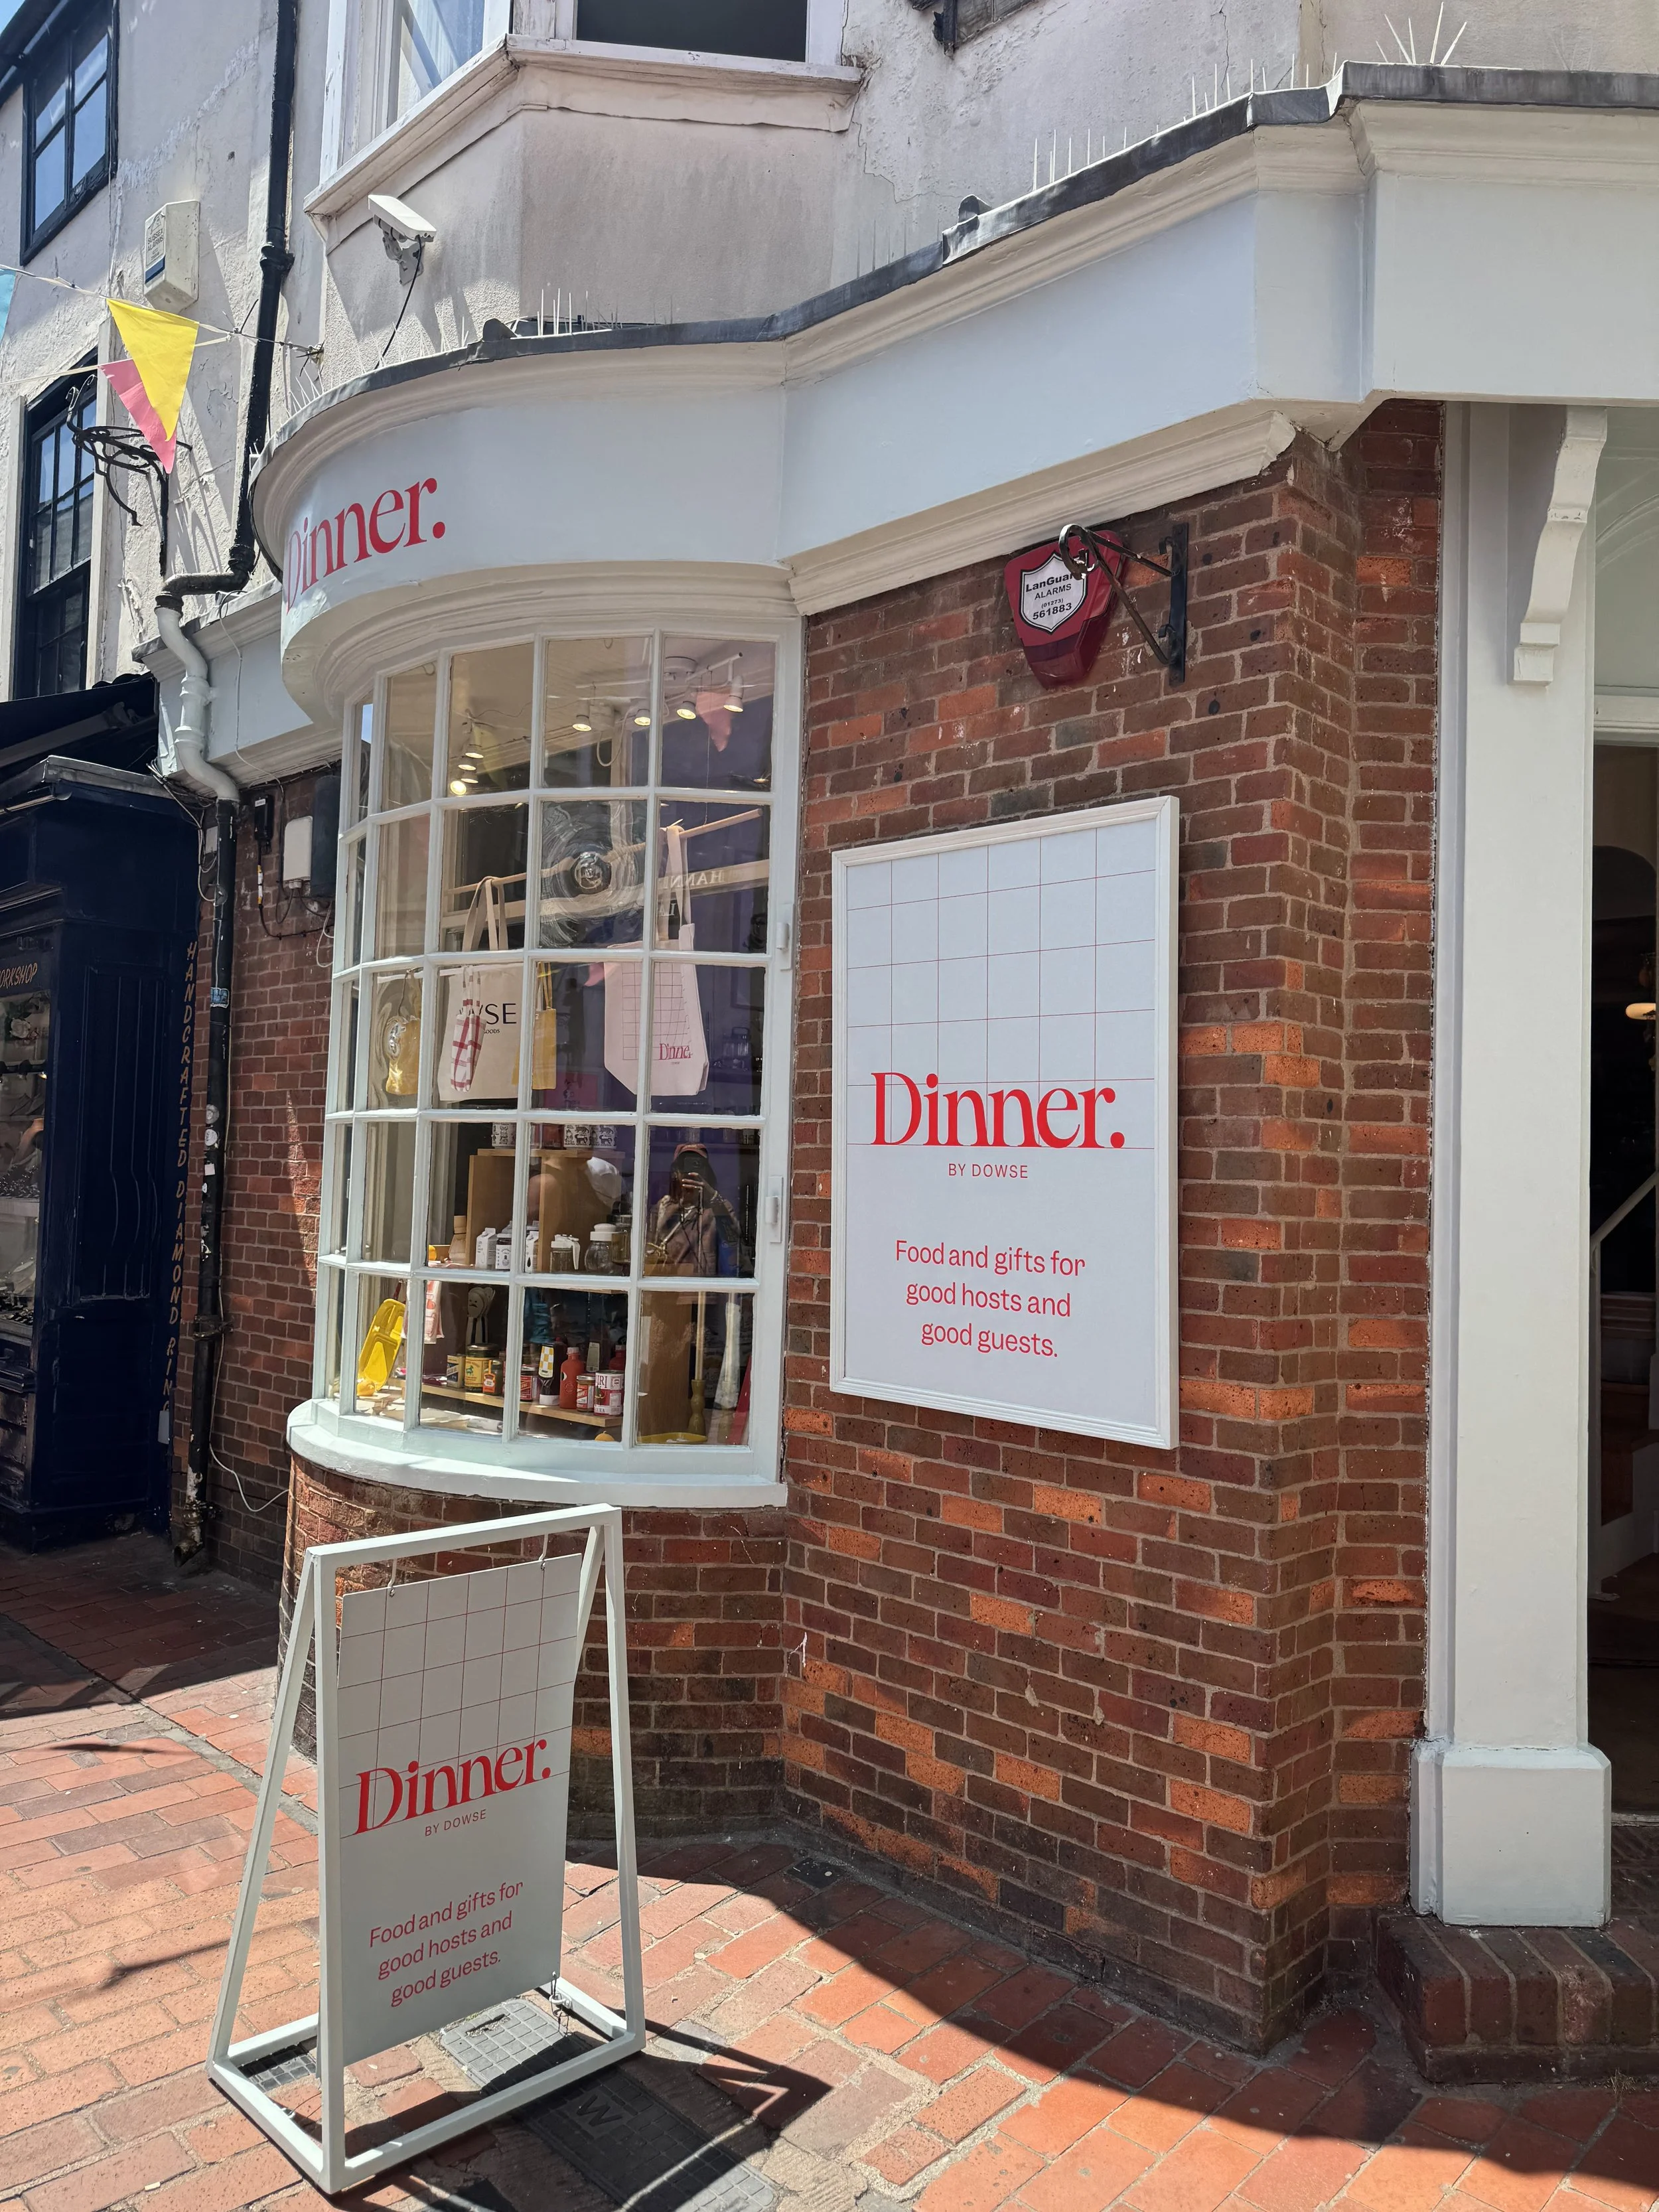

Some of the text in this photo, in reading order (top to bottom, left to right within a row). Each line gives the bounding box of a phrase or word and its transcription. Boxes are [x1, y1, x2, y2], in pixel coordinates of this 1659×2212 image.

[286, 478, 446, 615] Dinner.
[1026, 572, 1076, 592] LanGuar
[1035, 583, 1072, 600] ALARMS
[1033, 603, 1072, 620] 561883
[1041, 598, 1064, 609] (01273)
[0, 962, 38, 989] ORKSHOP
[177, 940, 197, 1168] HANDCRAFTED
[871, 1072, 1125, 1149] Dinner.
[948, 1163, 1029, 1179] BY DOWSE
[169, 1180, 185, 1325] DIAMOND
[895, 1240, 1086, 1276] Food and gifts for
[905, 1282, 1071, 1318] good hosts and
[921, 1323, 1058, 1359] good guests.
[163, 1337, 176, 1411] RIN
[353, 1739, 551, 1835] Dinner.
[424, 1809, 487, 1837] BY DOWSE
[370, 1881, 524, 1948] Food and gifts for
[378, 1911, 512, 1980] good hosts and
[390, 1950, 502, 2008] good guests.
